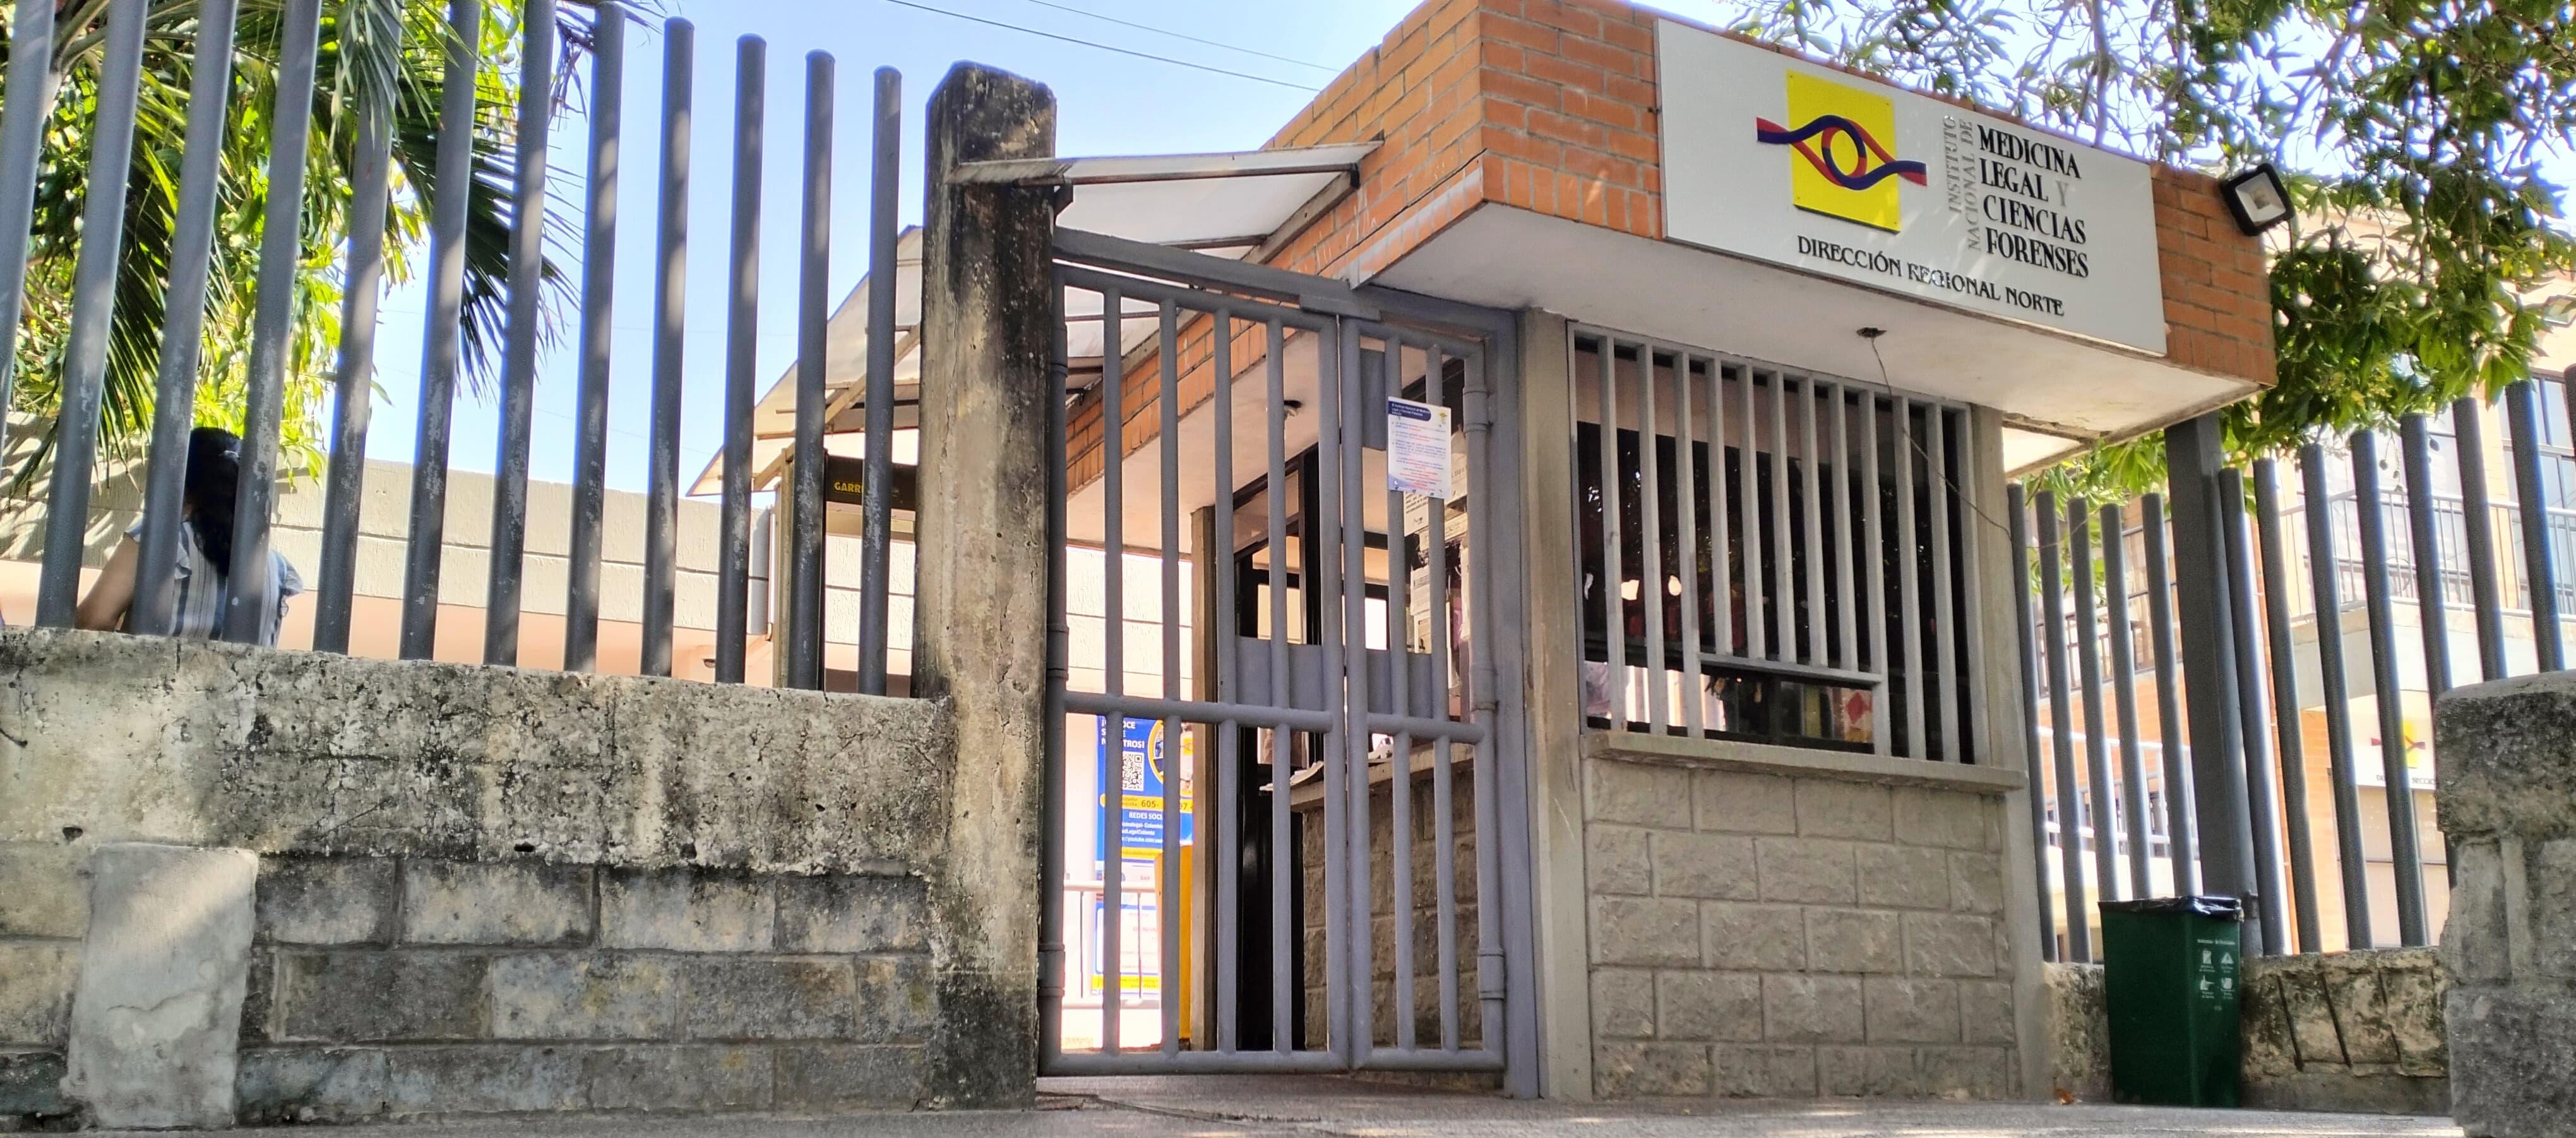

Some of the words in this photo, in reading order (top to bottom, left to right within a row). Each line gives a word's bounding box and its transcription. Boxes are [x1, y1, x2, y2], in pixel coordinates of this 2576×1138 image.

[1959, 118, 1974, 146] DE
[1977, 124, 2082, 179] MEDICINA
[1943, 114, 1962, 213] INSTITUTO
[1979, 157, 2049, 202] LEGAL
[2055, 180, 2069, 208] Y
[1962, 153, 1981, 252] NACIONAL
[1983, 194, 2087, 245] CIENCIAS
[1797, 235, 1902, 277] DIRECCIÓN
[1907, 262, 2001, 301] REGIONAL
[2005, 286, 2065, 316] NORTE
[1985, 226, 2089, 279] FORENSES
[834, 481, 862, 494] GARR
[1129, 812, 1148, 820] REDES
